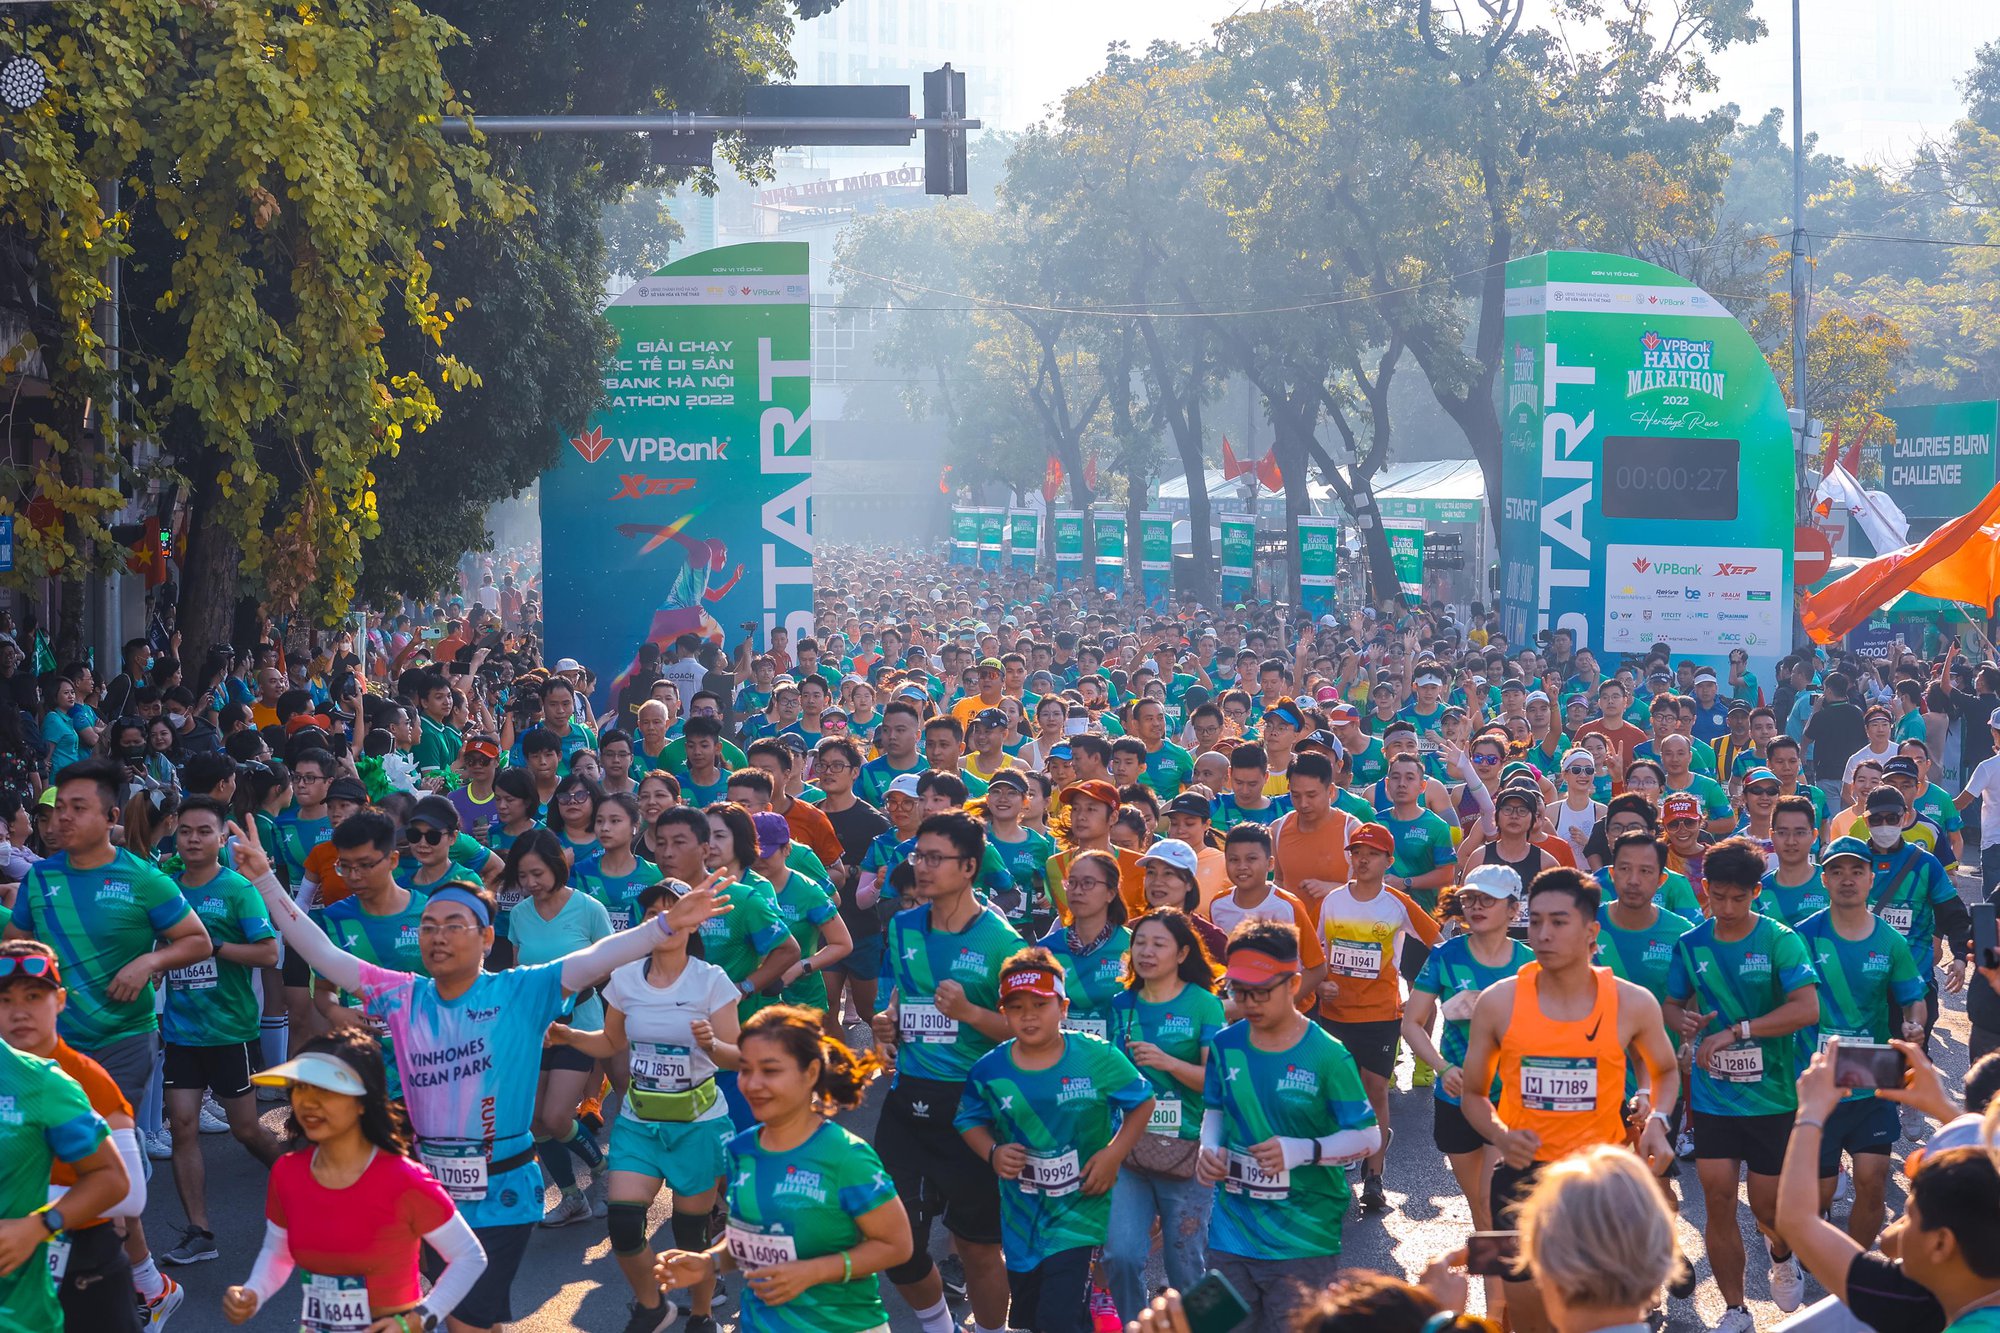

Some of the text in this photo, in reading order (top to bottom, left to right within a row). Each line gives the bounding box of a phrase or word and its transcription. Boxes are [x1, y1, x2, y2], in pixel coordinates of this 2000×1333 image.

[803, 177, 838, 198] HÁT
[843, 171, 883, 192] MÚA
[886, 161, 916, 186] RỐI
[752, 288, 781, 296] VPBank
[636, 339, 733, 355] GIẢI CHẠY
[1663, 338, 1711, 353] VPBank
[638, 355, 734, 371] TẾ DI SẢN
[1643, 351, 1710, 370] HANOI
[1514, 362, 1535, 381] HANOI
[668, 374, 696, 389] HÀ
[701, 374, 734, 390] NỘI
[1626, 369, 1725, 401] MARATHON
[685, 394, 735, 406] 2022
[1509, 384, 1538, 416] MARATHON
[1662, 396, 1690, 406] 2022
[1630, 408, 1720, 431] Heritage Race
[618, 437, 729, 462] VPBank
[1893, 436, 1950, 458] CALORIES
[1953, 434, 1990, 456] BURN
[1616, 466, 1728, 492] 00:00:27
[1892, 464, 1962, 486] CHALLENGE
[608, 474, 698, 500] XTEP
[758, 337, 813, 666] START
[1538, 343, 1595, 655] START
[1505, 497, 1538, 522] START
[1224, 538, 1252, 546] MARATHON
[1302, 543, 1333, 552] MARATHON
[1654, 562, 1758, 576] VPBank XTEP
[1685, 586, 1701, 600] be
[1855, 647, 1888, 657] 15000
[668, 672, 695, 680] COACH
[104, 885, 130, 893] HANOI
[94, 891, 134, 904] MARATHON
[203, 900, 224, 908] HANOI
[198, 906, 228, 918] MARATHON
[1884, 914, 1907, 926] 13144
[960, 954, 984, 965] HANOI
[1334, 952, 1374, 967] M 11941
[184, 964, 213, 978] 16644
[951, 960, 989, 977] MARATHON
[1008, 972, 1041, 982] HANOI
[1011, 978, 1036, 986] 2022
[904, 1013, 952, 1029] M 13108
[1165, 1019, 1190, 1028] HANOI
[1156, 1026, 1194, 1038] MARATHON
[410, 1038, 484, 1067] VINHOMES
[409, 1054, 492, 1088] OCEAN PARK
[634, 1060, 684, 1076] M 18570
[1725, 1058, 1756, 1070] 12816
[1286, 1072, 1315, 1085] HANOI
[1526, 1076, 1588, 1095] M 17189
[1062, 1082, 1091, 1092] HANOI
[1276, 1078, 1319, 1096] MARATHON
[1056, 1088, 1098, 1106] MARATHON
[1148, 1110, 1176, 1124] 800
[441, 1168, 480, 1184] 17059
[1038, 1162, 1073, 1182] 19992
[785, 1173, 820, 1188] HANOI
[772, 1182, 826, 1204] MARATHON
[748, 1244, 788, 1264] 16099
